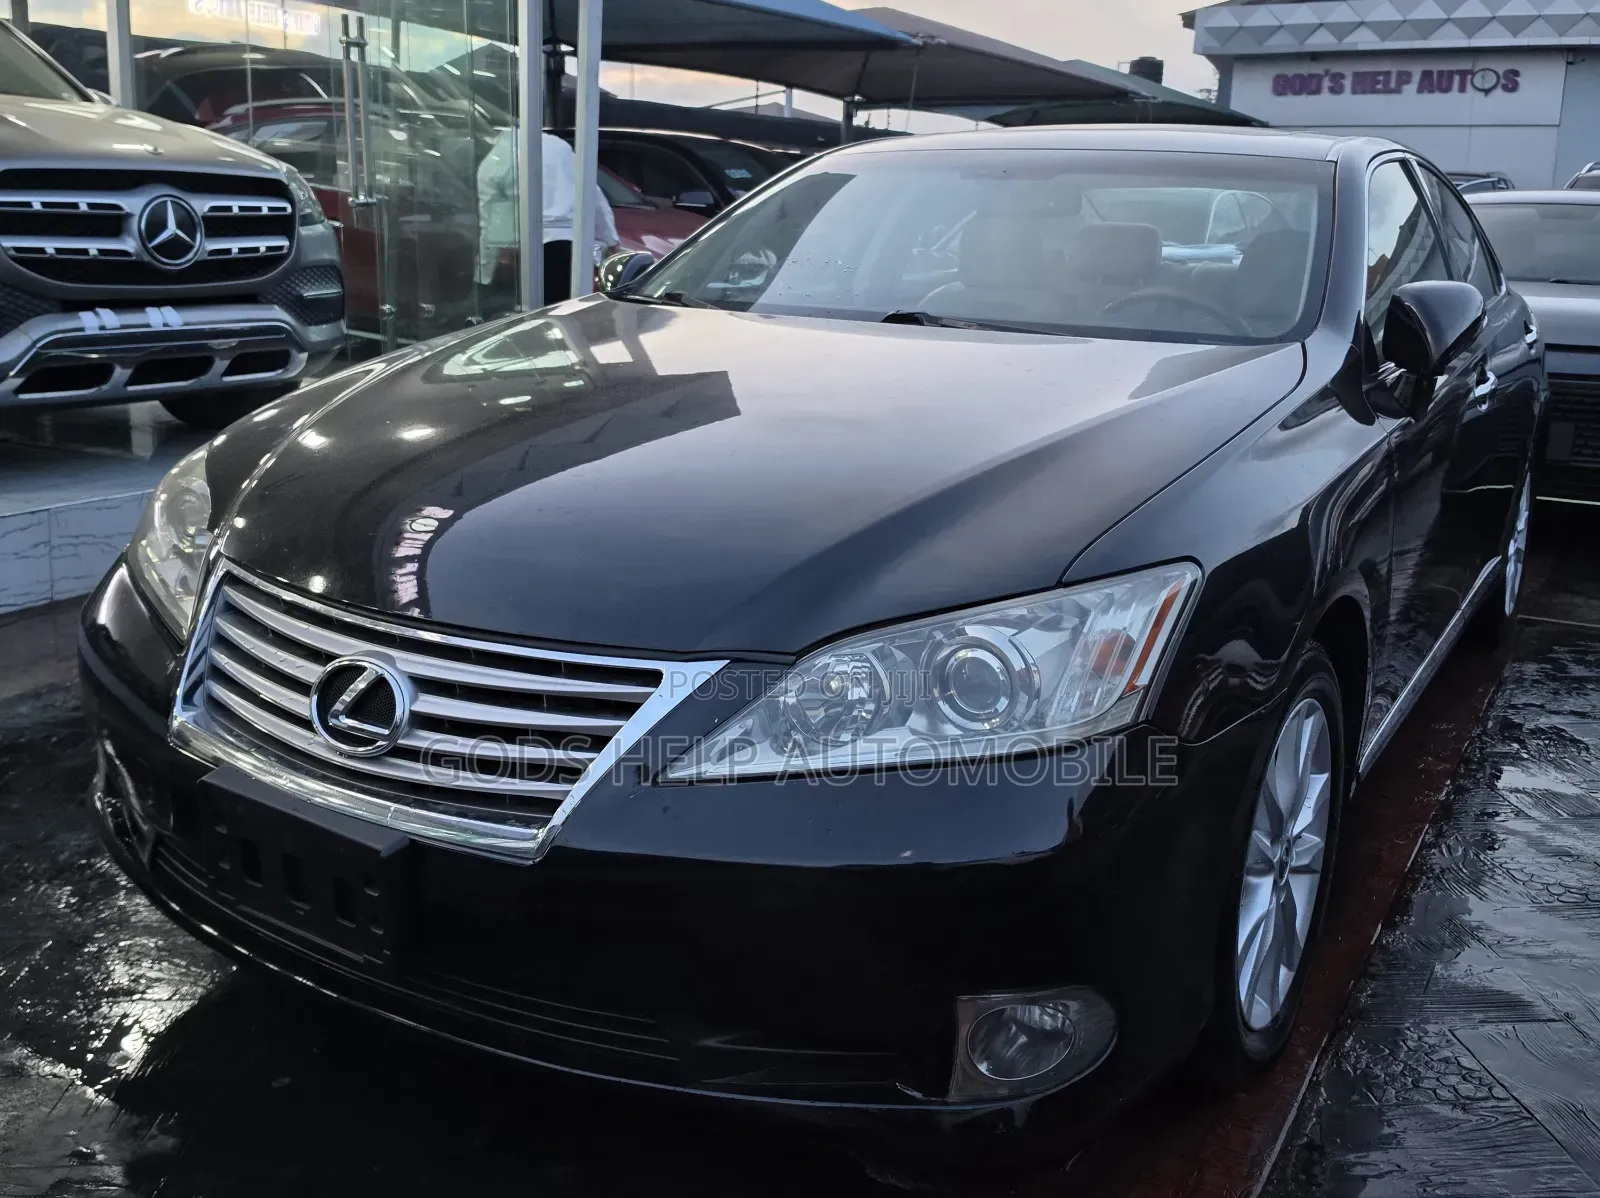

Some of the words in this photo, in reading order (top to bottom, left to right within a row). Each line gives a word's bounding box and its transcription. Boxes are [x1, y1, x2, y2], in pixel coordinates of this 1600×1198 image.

[1271, 68, 1346, 97] GOD'S
[1350, 70, 1413, 95] HELP
[1416, 67, 1521, 97] AUTOS
